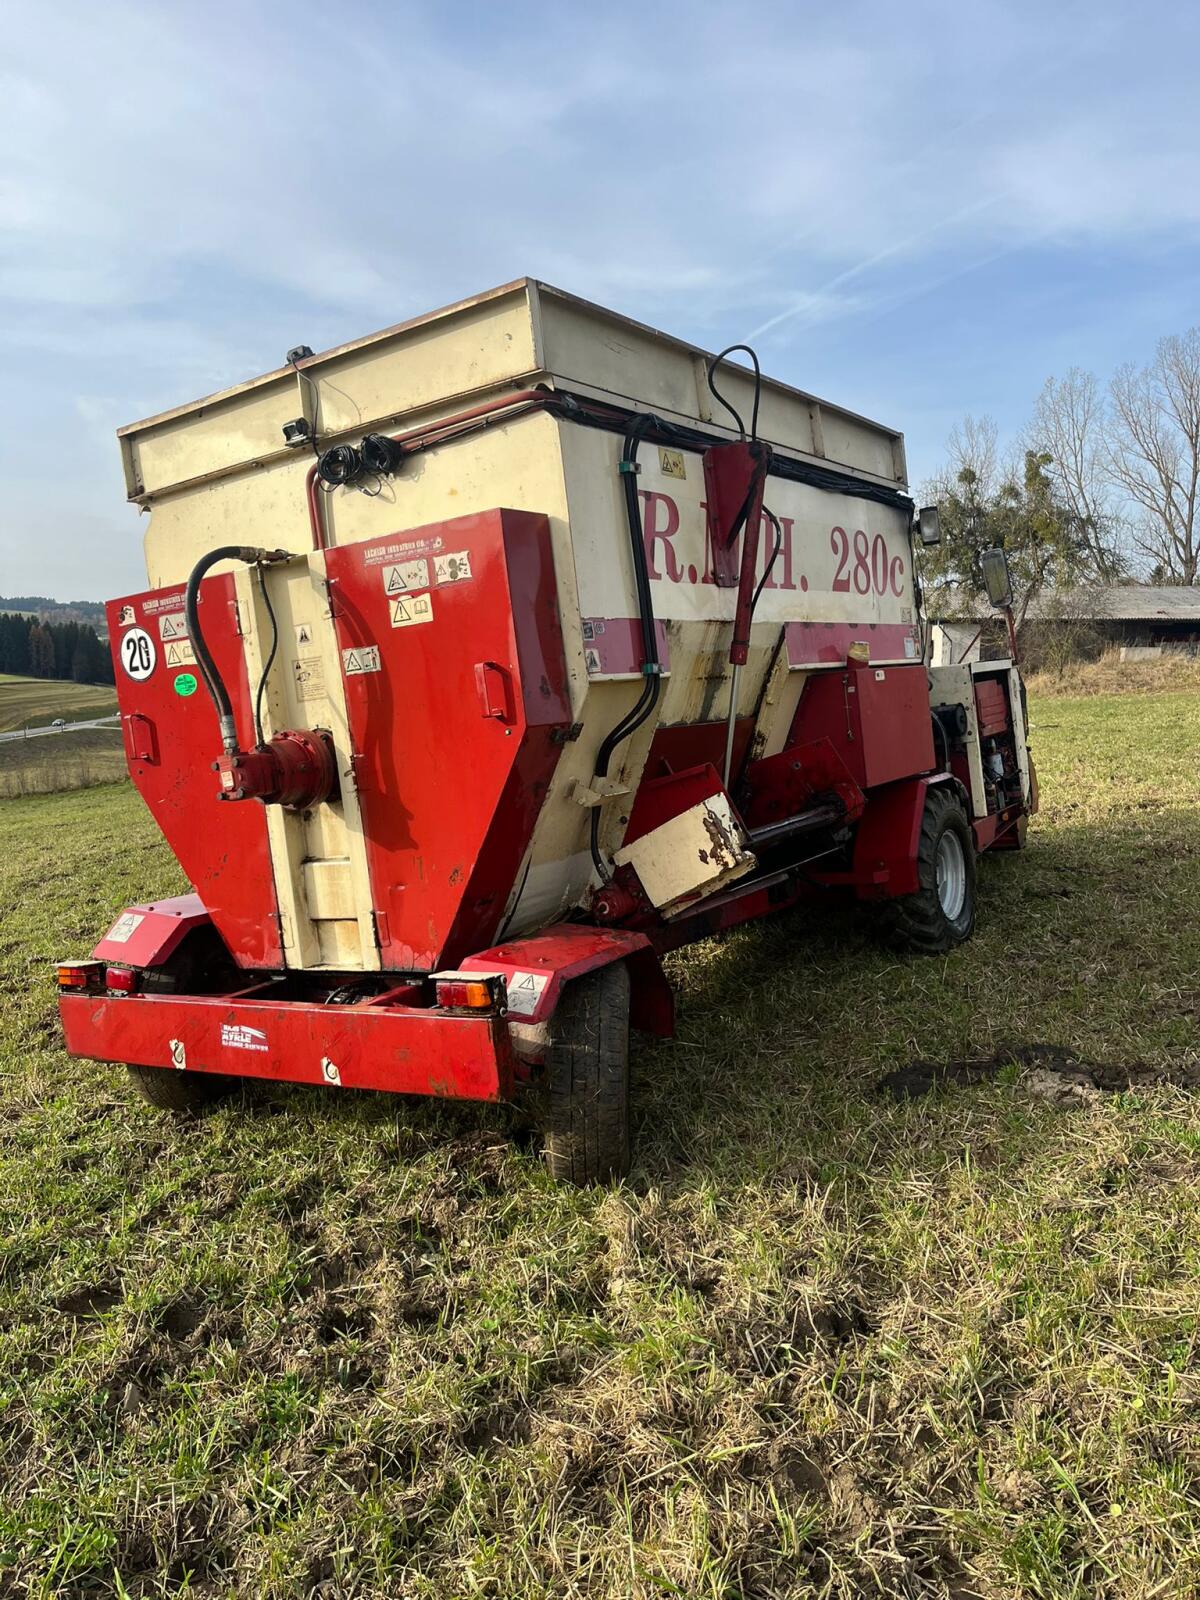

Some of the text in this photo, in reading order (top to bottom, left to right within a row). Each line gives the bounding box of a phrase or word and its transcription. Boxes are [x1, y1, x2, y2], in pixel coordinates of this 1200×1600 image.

[638, 489, 905, 598] R..H. 280c
[126, 636, 151, 673] 20
